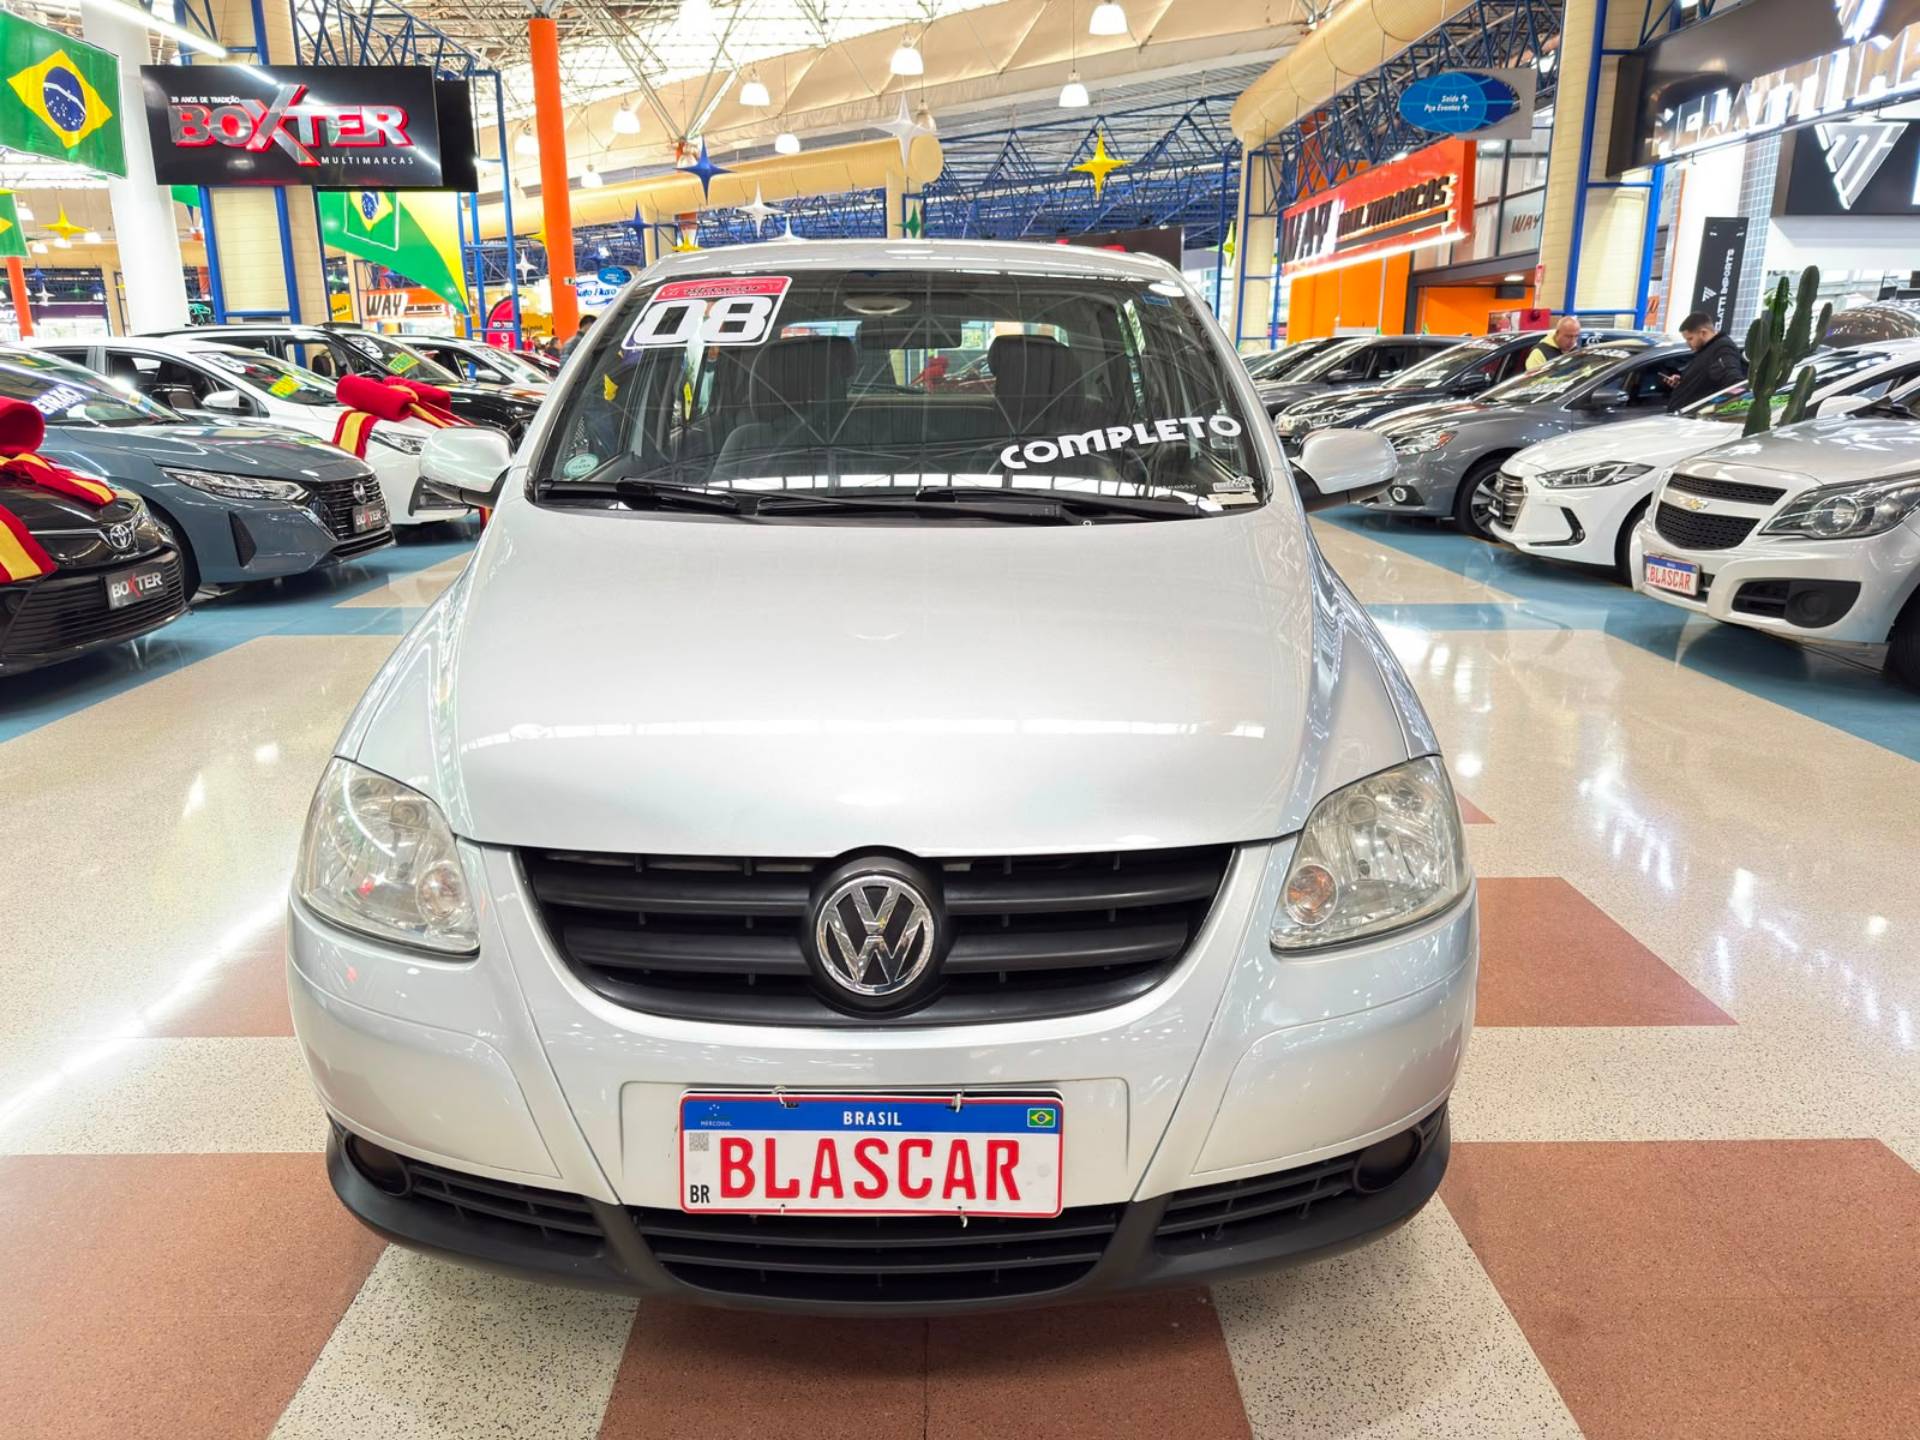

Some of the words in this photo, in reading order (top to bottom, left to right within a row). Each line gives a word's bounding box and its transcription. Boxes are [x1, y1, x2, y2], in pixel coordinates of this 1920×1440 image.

[210, 95, 240, 104] TRADIÇÃO
[168, 84, 415, 167] BOXTER
[320, 155, 415, 165] MULTIMARCAS
[1337, 175, 1450, 239] MULTIMARCAS
[1511, 214, 1542, 234] WAY
[366, 294, 403, 316] WAY
[632, 296, 773, 344] 08
[1000, 414, 1242, 469] COMPLETO
[111, 572, 163, 599] BOXTER
[1649, 566, 1692, 590] BLASCAR
[843, 1110, 903, 1127] BRASIL
[720, 1137, 1022, 1201] BLASCAR
[689, 1185, 711, 1204] BR
